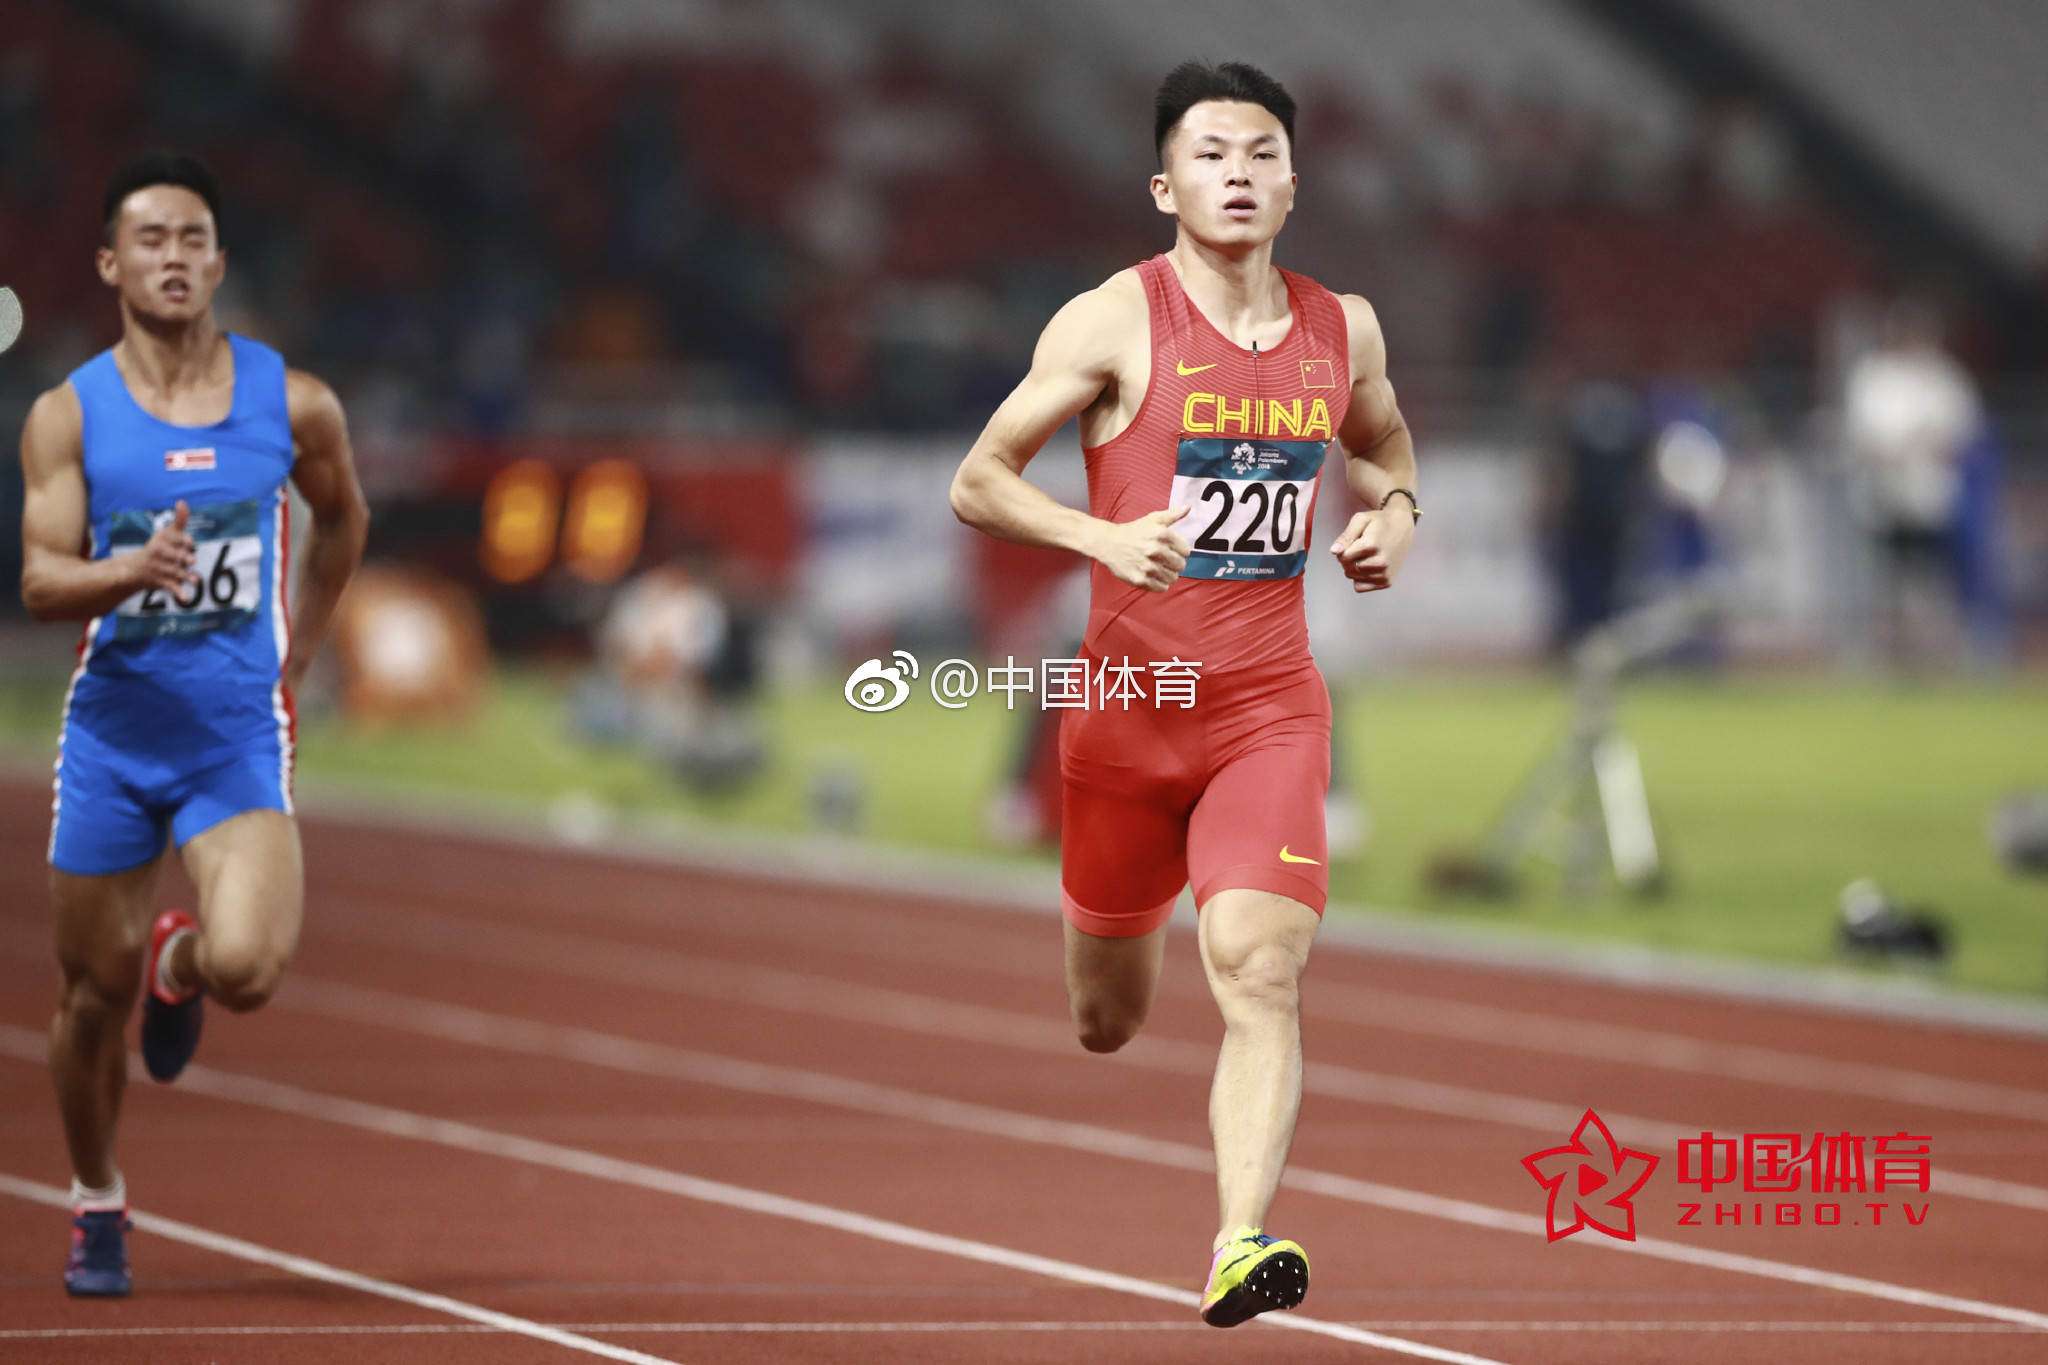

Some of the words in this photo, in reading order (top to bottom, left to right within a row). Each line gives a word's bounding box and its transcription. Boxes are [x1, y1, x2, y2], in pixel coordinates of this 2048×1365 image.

[1182, 392, 1332, 440] CHINA
[1193, 480, 1300, 553] 220
[1237, 567, 1275, 575] PERTAMINA
